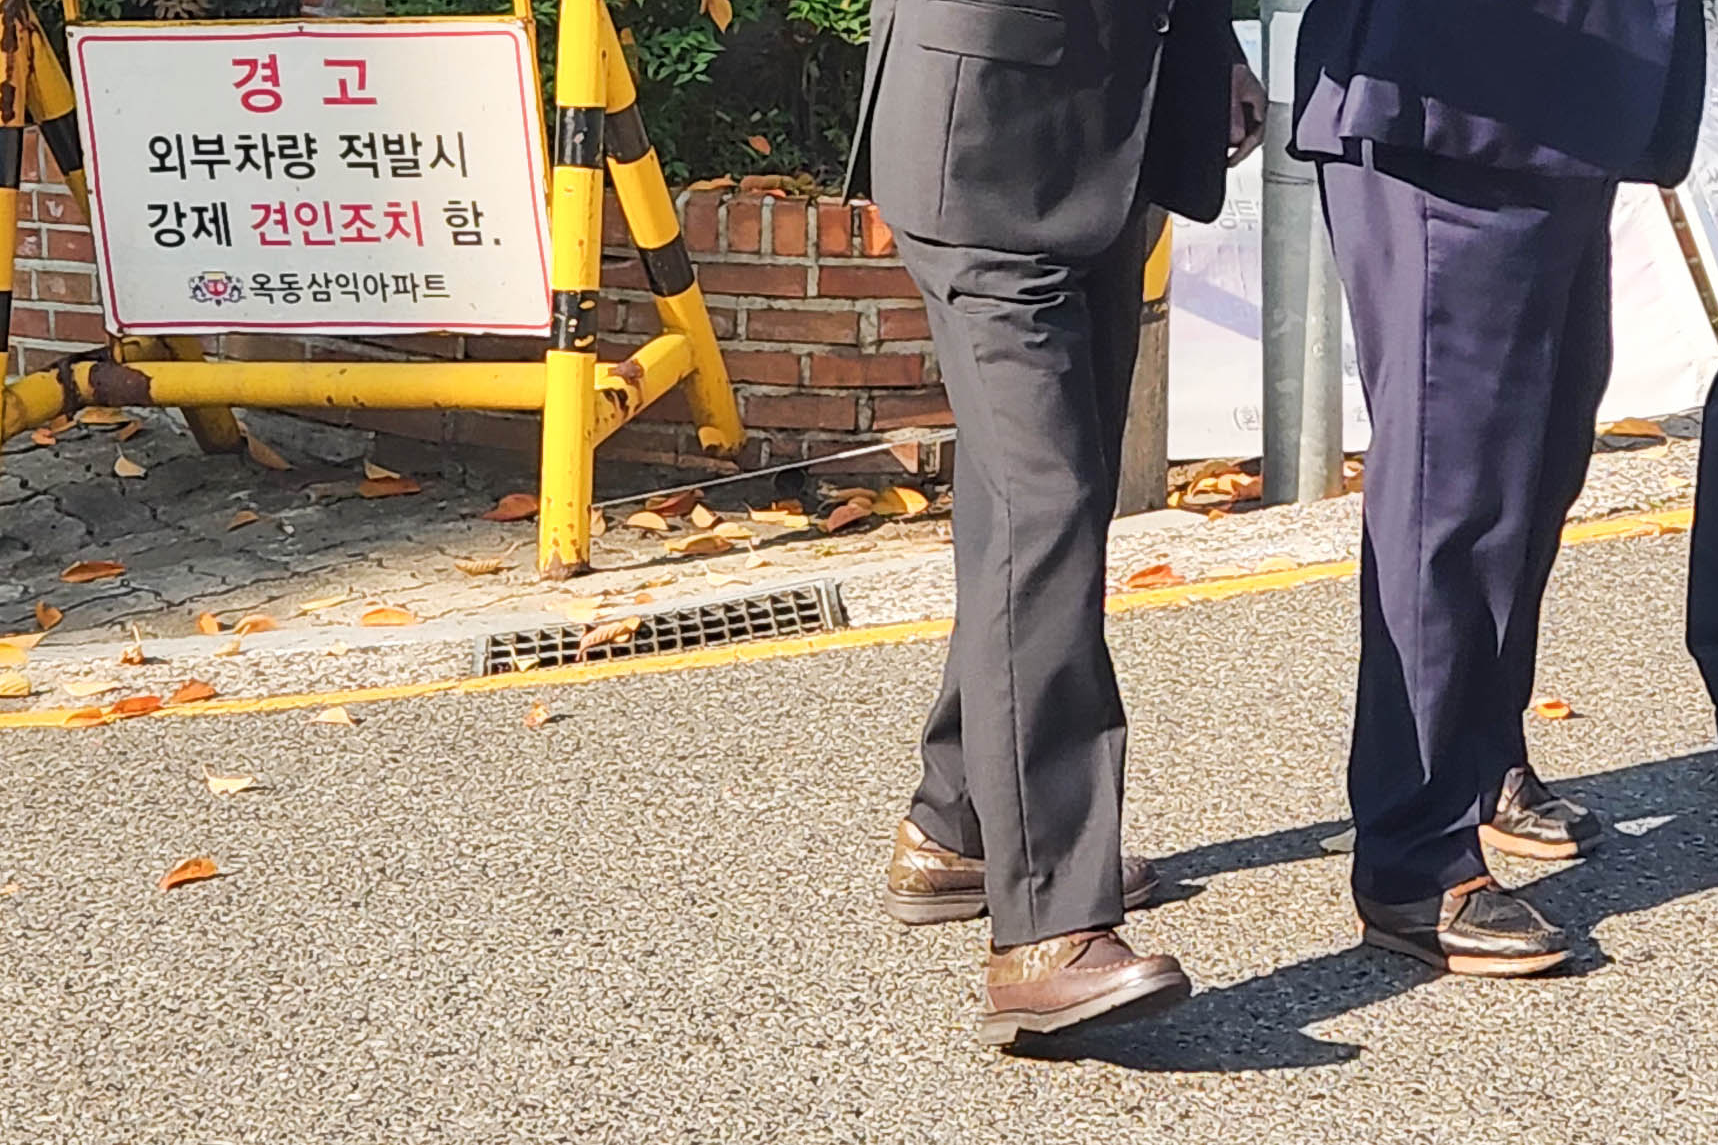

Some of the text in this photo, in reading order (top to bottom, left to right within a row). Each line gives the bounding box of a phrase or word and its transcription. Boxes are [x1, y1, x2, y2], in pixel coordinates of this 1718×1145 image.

[232, 53, 378, 113] 경 고
[148, 130, 469, 180] 외부차량 적발시
[147, 200, 502, 248] 강제 견인조치 함.
[249, 271, 451, 305] 옥동삼익아파트
